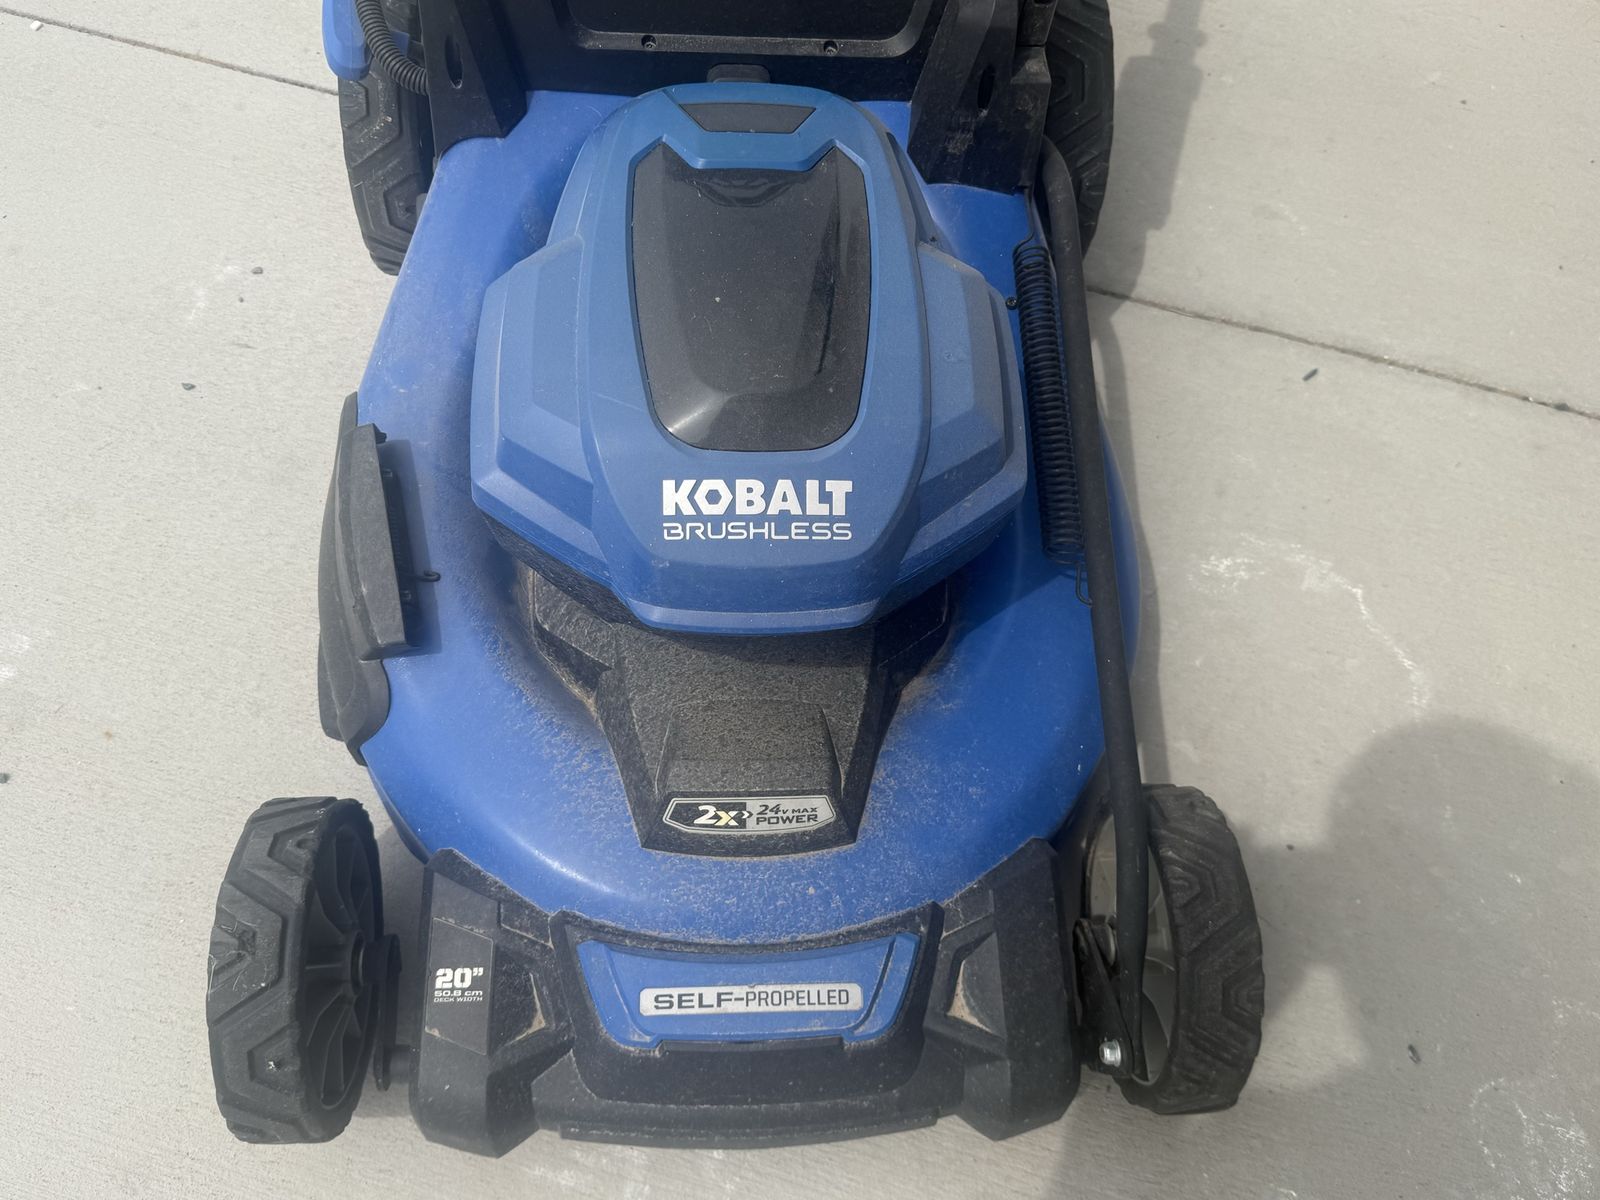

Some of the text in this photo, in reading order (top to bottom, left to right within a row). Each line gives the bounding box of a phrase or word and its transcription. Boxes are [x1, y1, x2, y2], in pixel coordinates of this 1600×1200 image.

[662, 479, 853, 516] KOBALT
[662, 521, 853, 540] BRUSHLESS
[755, 814, 819, 826] POWER
[653, 988, 850, 1010] SELF-PROPELLED
